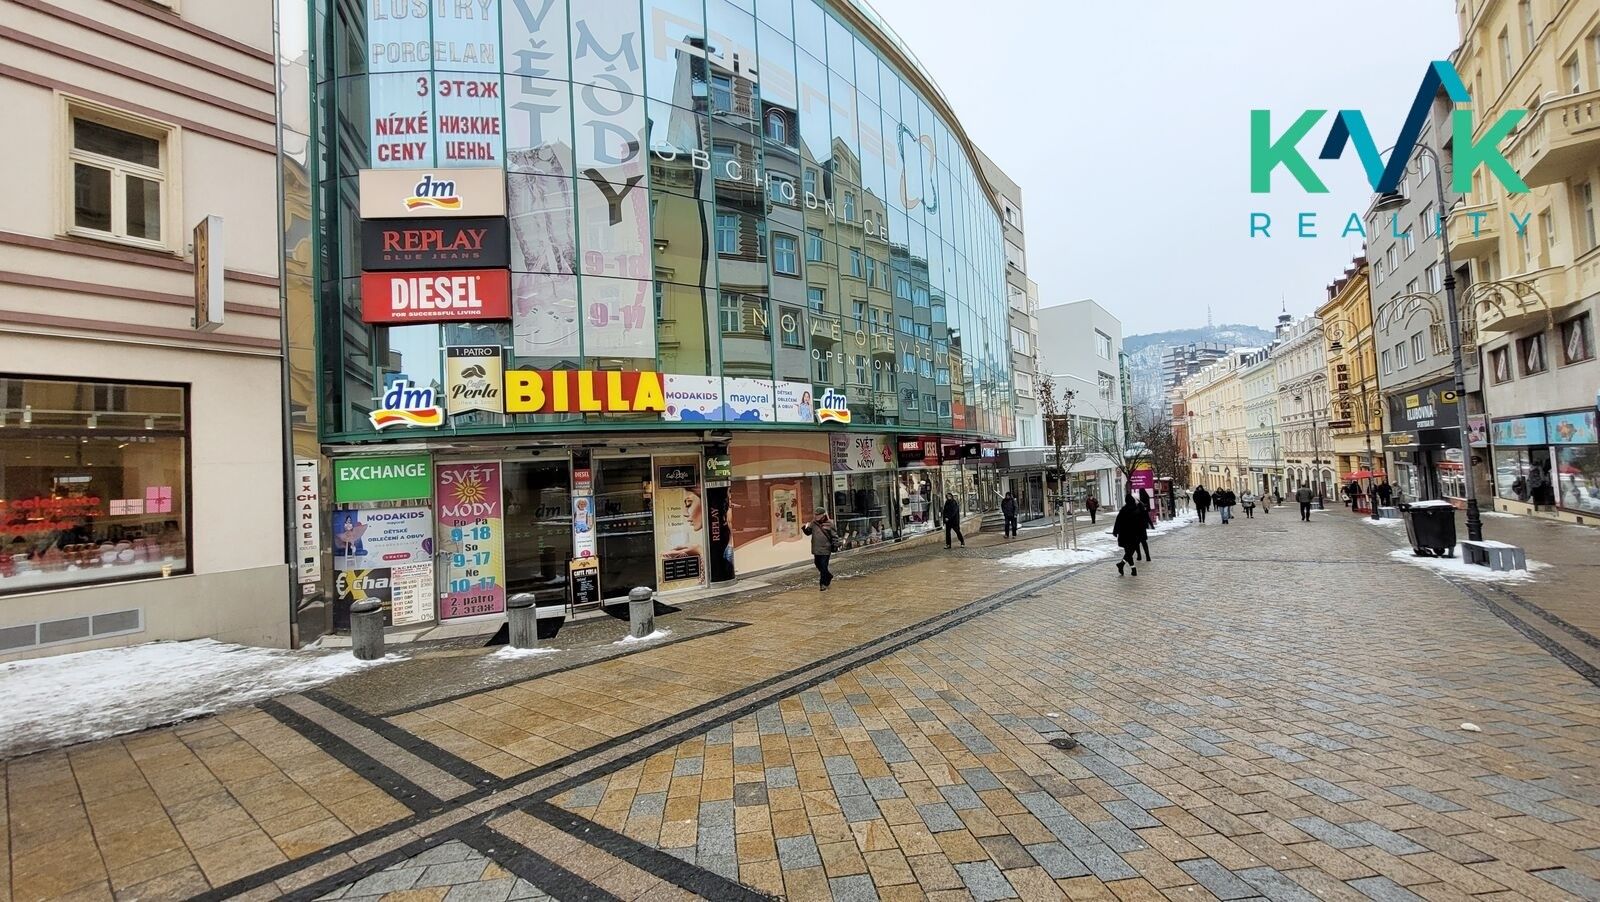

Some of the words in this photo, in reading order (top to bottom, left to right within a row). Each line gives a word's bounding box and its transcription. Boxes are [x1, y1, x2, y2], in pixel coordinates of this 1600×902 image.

[372, 41, 495, 64] PORCELAN
[417, 77, 428, 96] 3
[439, 80, 499, 98] этаж
[376, 110, 428, 136] NÍZKÉ
[440, 116, 500, 135] НИЗКИЕ
[378, 143, 427, 162] CENY
[446, 142, 495, 161] ЦЕНЫ
[416, 176, 454, 197] dm
[383, 229, 488, 252] REPLAY
[391, 276, 482, 309] DIESEL
[752, 308, 841, 341] NOVĚ
[812, 349, 855, 365] OPEN
[863, 358, 916, 375] MONDAY
[385, 382, 432, 408] dm
[452, 384, 498, 399] Perla
[505, 370, 665, 412] BILLA
[666, 392, 718, 400] MODAKIDS
[730, 393, 769, 403] mayoral
[824, 391, 846, 410] dm
[855, 436, 874, 448] SVĚT
[903, 441, 919, 449] DIESEL
[340, 463, 426, 481] EXCHANGE
[441, 466, 495, 485] SVĚT
[296, 476, 316, 539] EXCHANGE
[367, 511, 425, 522] MODAKIDS
[441, 502, 496, 518] MÓDY
[454, 519, 466, 527] Po
[710, 507, 721, 541] REPLAY
[450, 526, 491, 542] 9-18
[465, 543, 478, 552] So
[453, 552, 491, 567] 9-17
[466, 569, 479, 577] Ne
[450, 576, 496, 593] 10-17
[451, 598, 460, 606] 2.
[464, 595, 494, 605] patro
